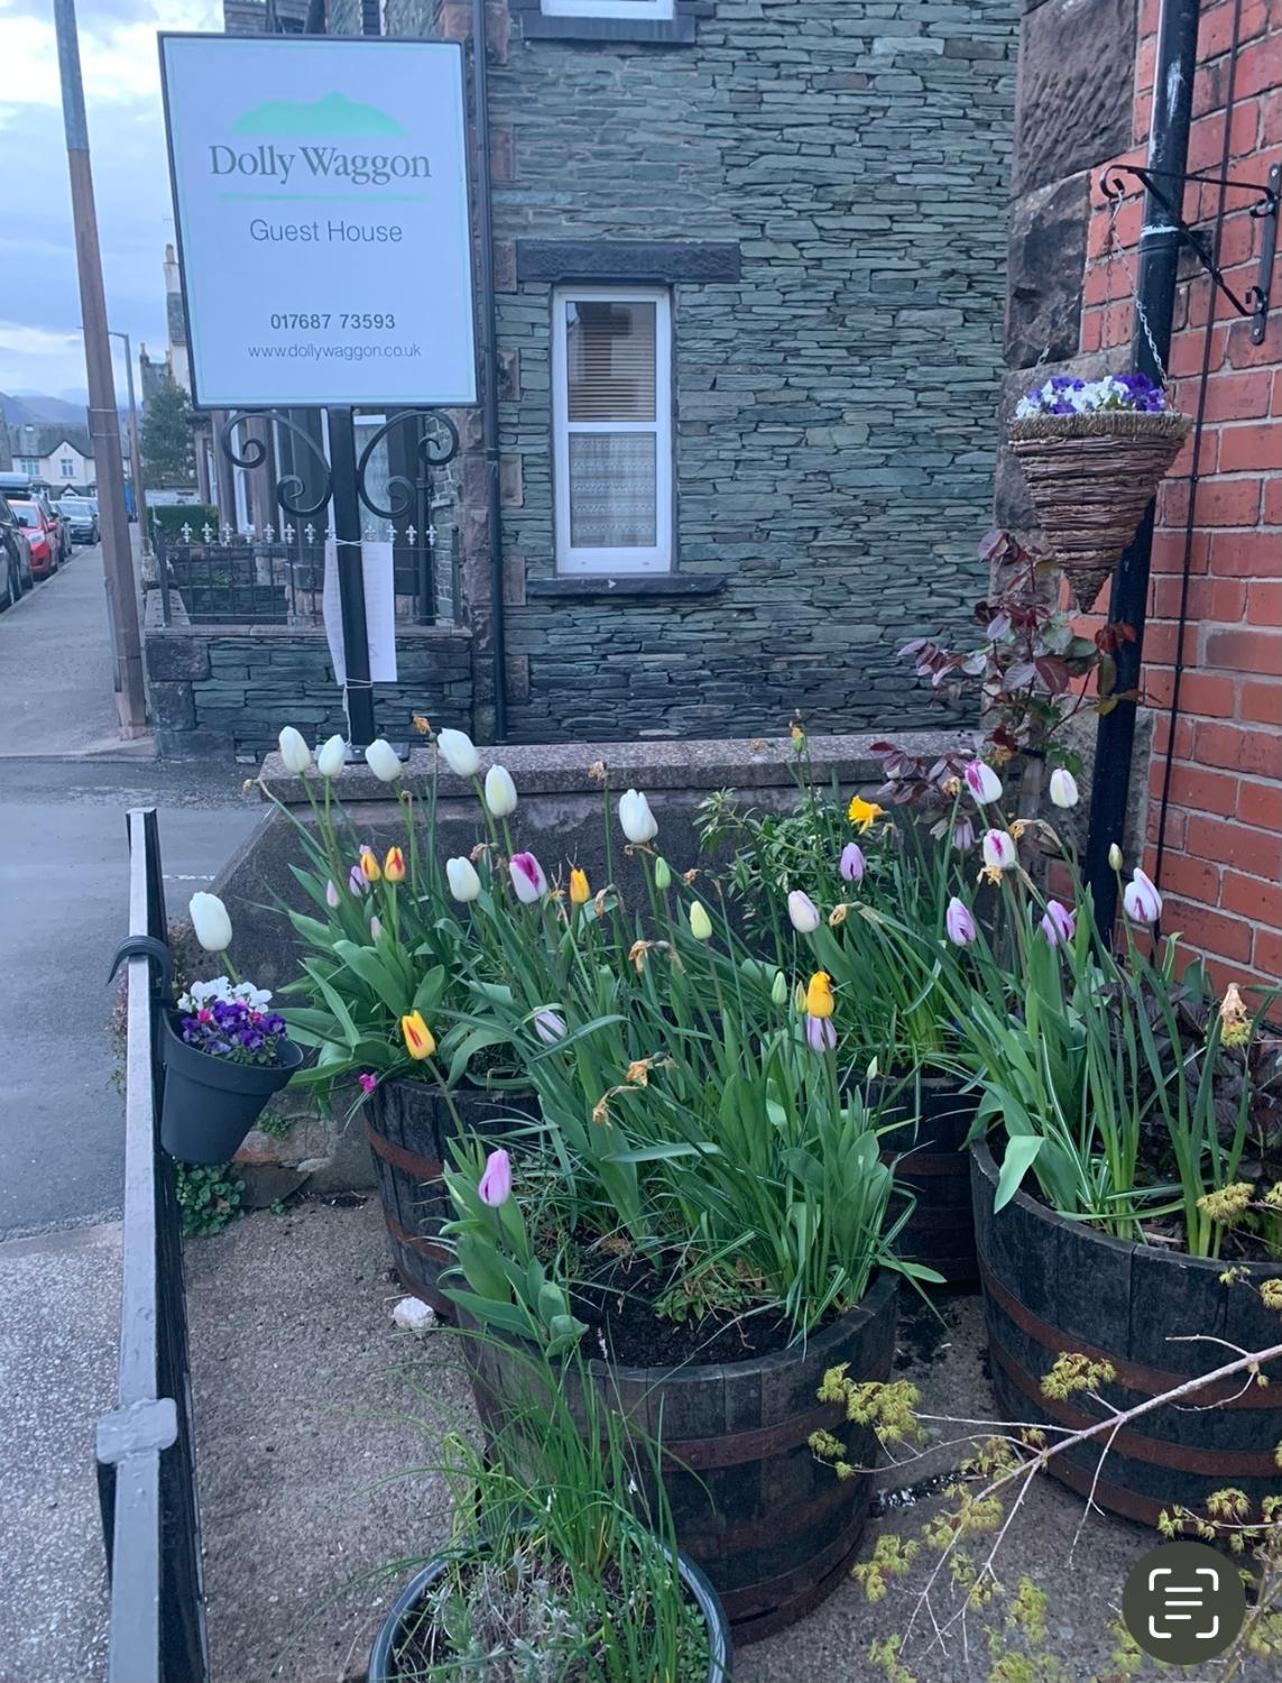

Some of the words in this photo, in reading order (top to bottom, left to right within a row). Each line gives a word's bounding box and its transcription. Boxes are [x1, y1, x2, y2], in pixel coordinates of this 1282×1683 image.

[208, 145, 295, 185] Dolly
[299, 147, 433, 186] Waggon
[249, 219, 320, 242] Guest
[328, 221, 403, 243] House
[270, 314, 331, 329] 017687
[340, 314, 396, 329] 73593
[248, 344, 421, 361] www.dollywaggon.co.uk
